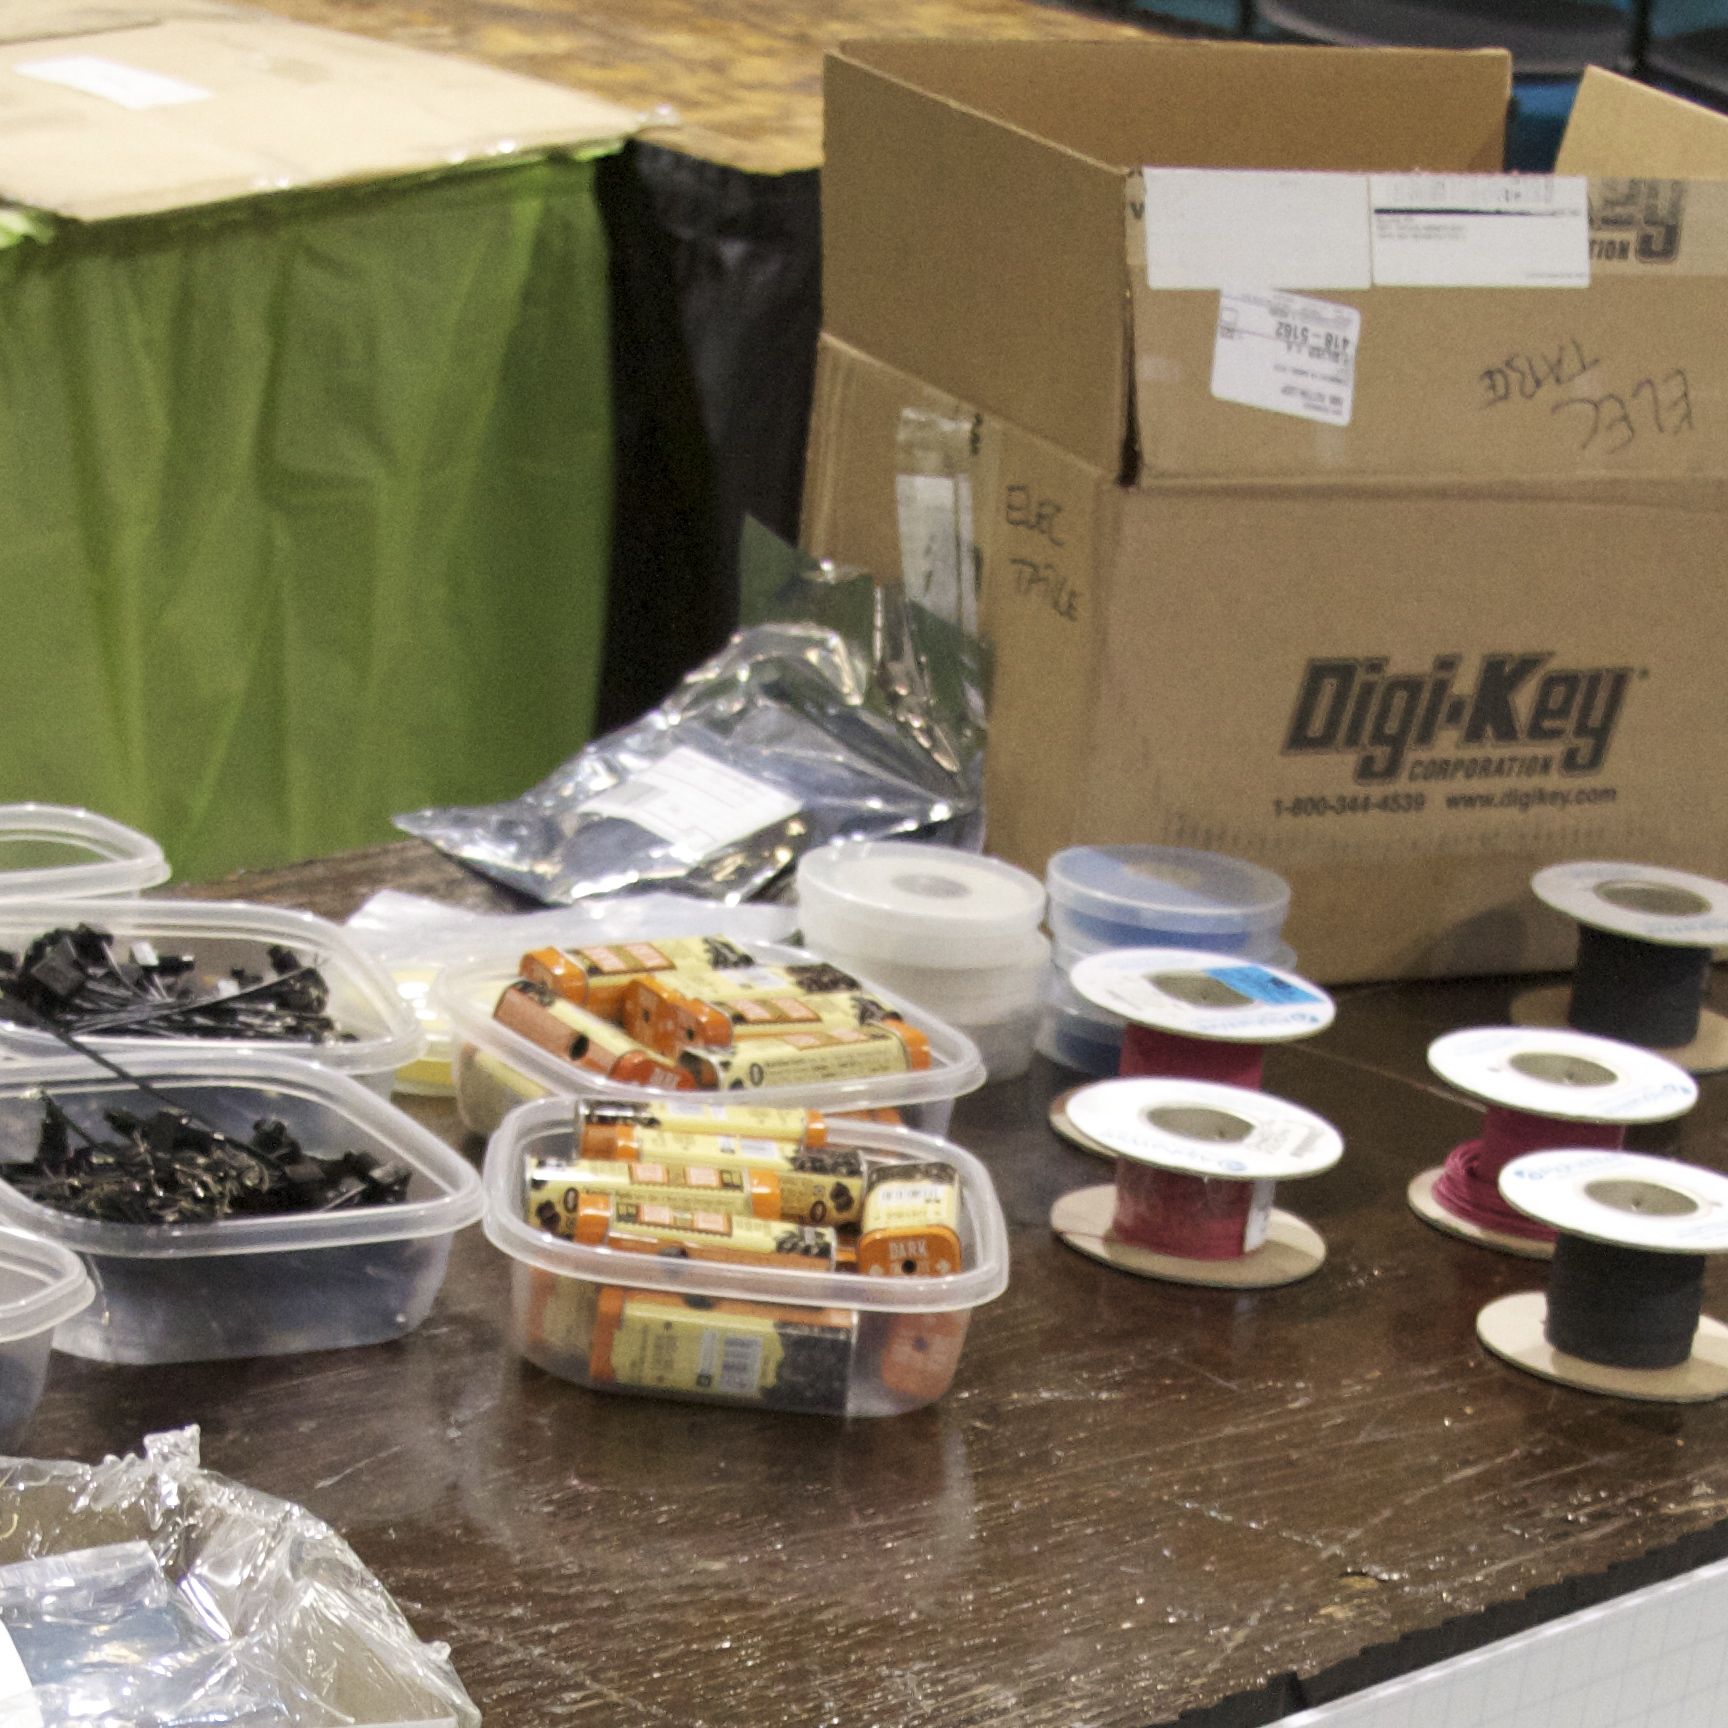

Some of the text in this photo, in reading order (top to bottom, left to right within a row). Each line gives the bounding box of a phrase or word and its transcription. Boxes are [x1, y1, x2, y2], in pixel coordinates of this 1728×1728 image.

[1549, 367, 1695, 454] ELEC
[1281, 652, 1635, 785] Digi-Key
[1408, 756, 1553, 782] CORPORATION
[1445, 787, 1617, 812] www.digikey.com
